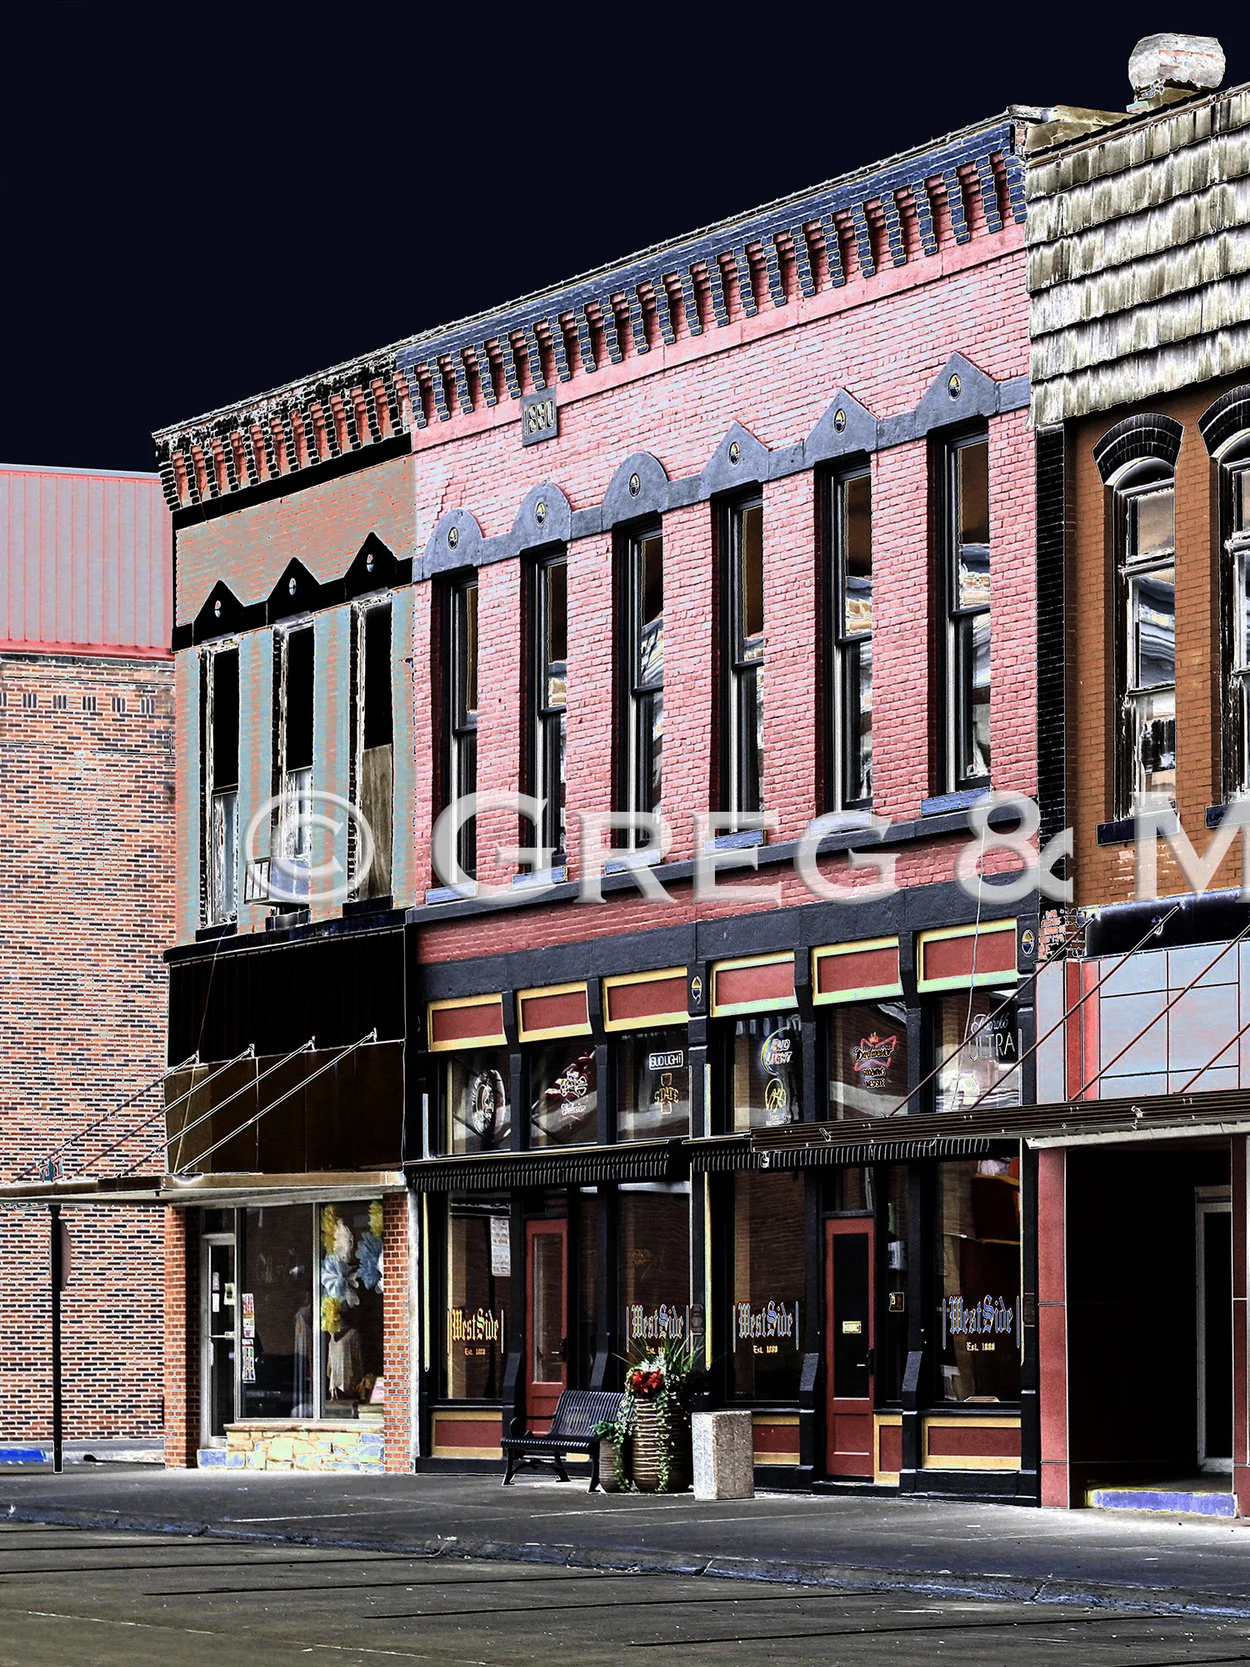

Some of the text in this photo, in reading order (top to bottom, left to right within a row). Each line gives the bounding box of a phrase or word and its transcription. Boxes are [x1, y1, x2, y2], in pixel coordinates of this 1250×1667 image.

[524, 399, 554, 436] 1880
[770, 1038, 791, 1052] BUD
[968, 1032, 1016, 1062] ULTRA
[650, 1056, 664, 1067] BUD
